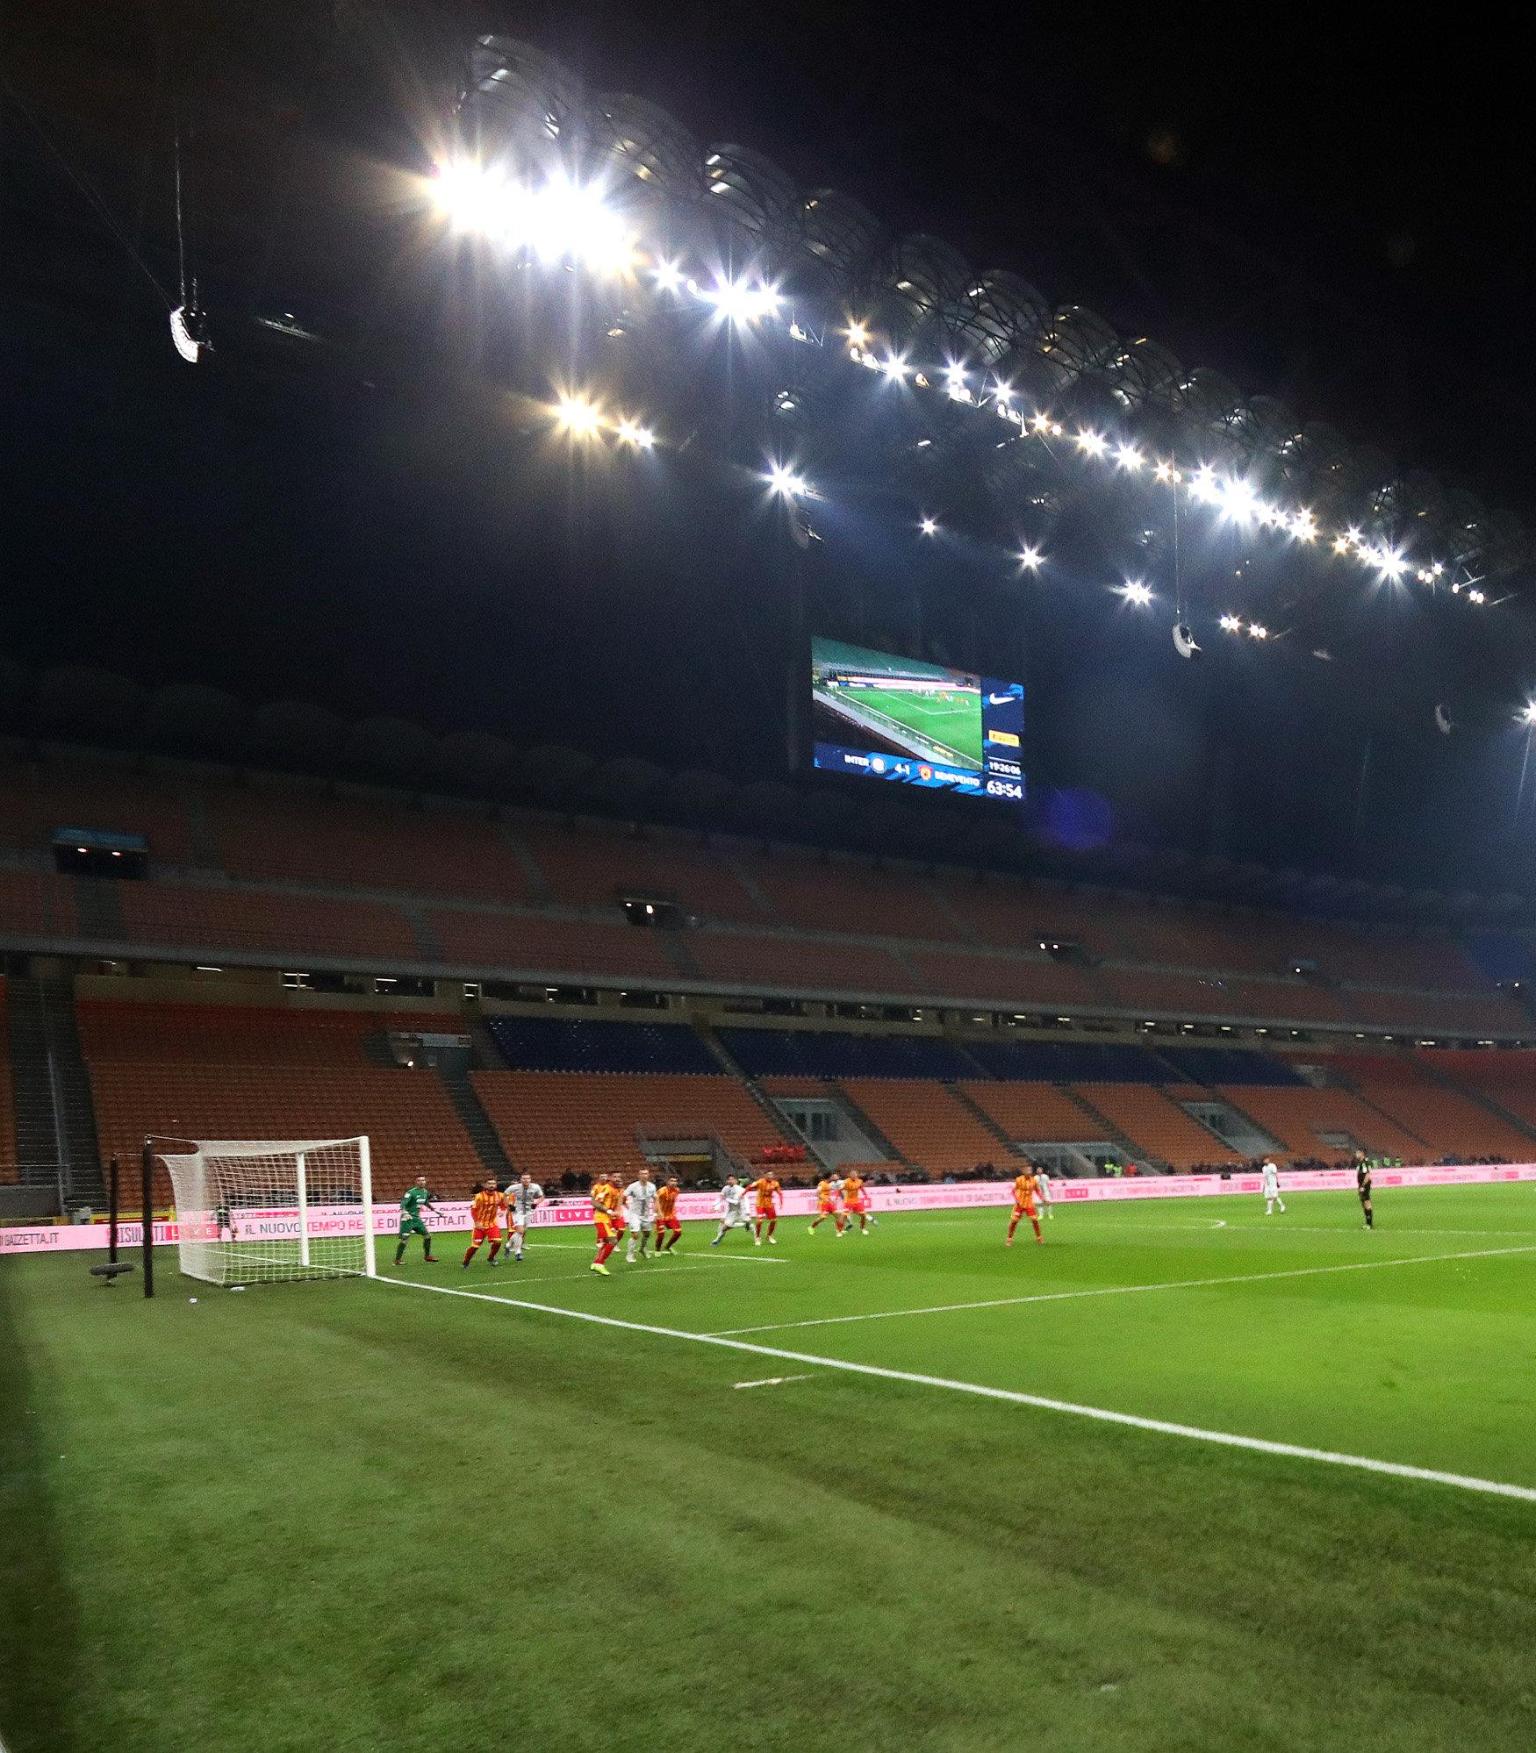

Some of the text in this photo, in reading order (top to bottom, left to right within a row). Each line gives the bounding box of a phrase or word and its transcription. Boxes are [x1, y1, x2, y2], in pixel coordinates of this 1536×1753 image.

[986, 780, 1023, 799] 63:54
[559, 1210, 591, 1220] LIVE
[170, 1224, 214, 1239] LVE
[245, 1214, 467, 1235] IL NUOVO TEMPO RELE DI ZETTA.IT
[4, 1231, 60, 1247] GAZZETTA.IT
